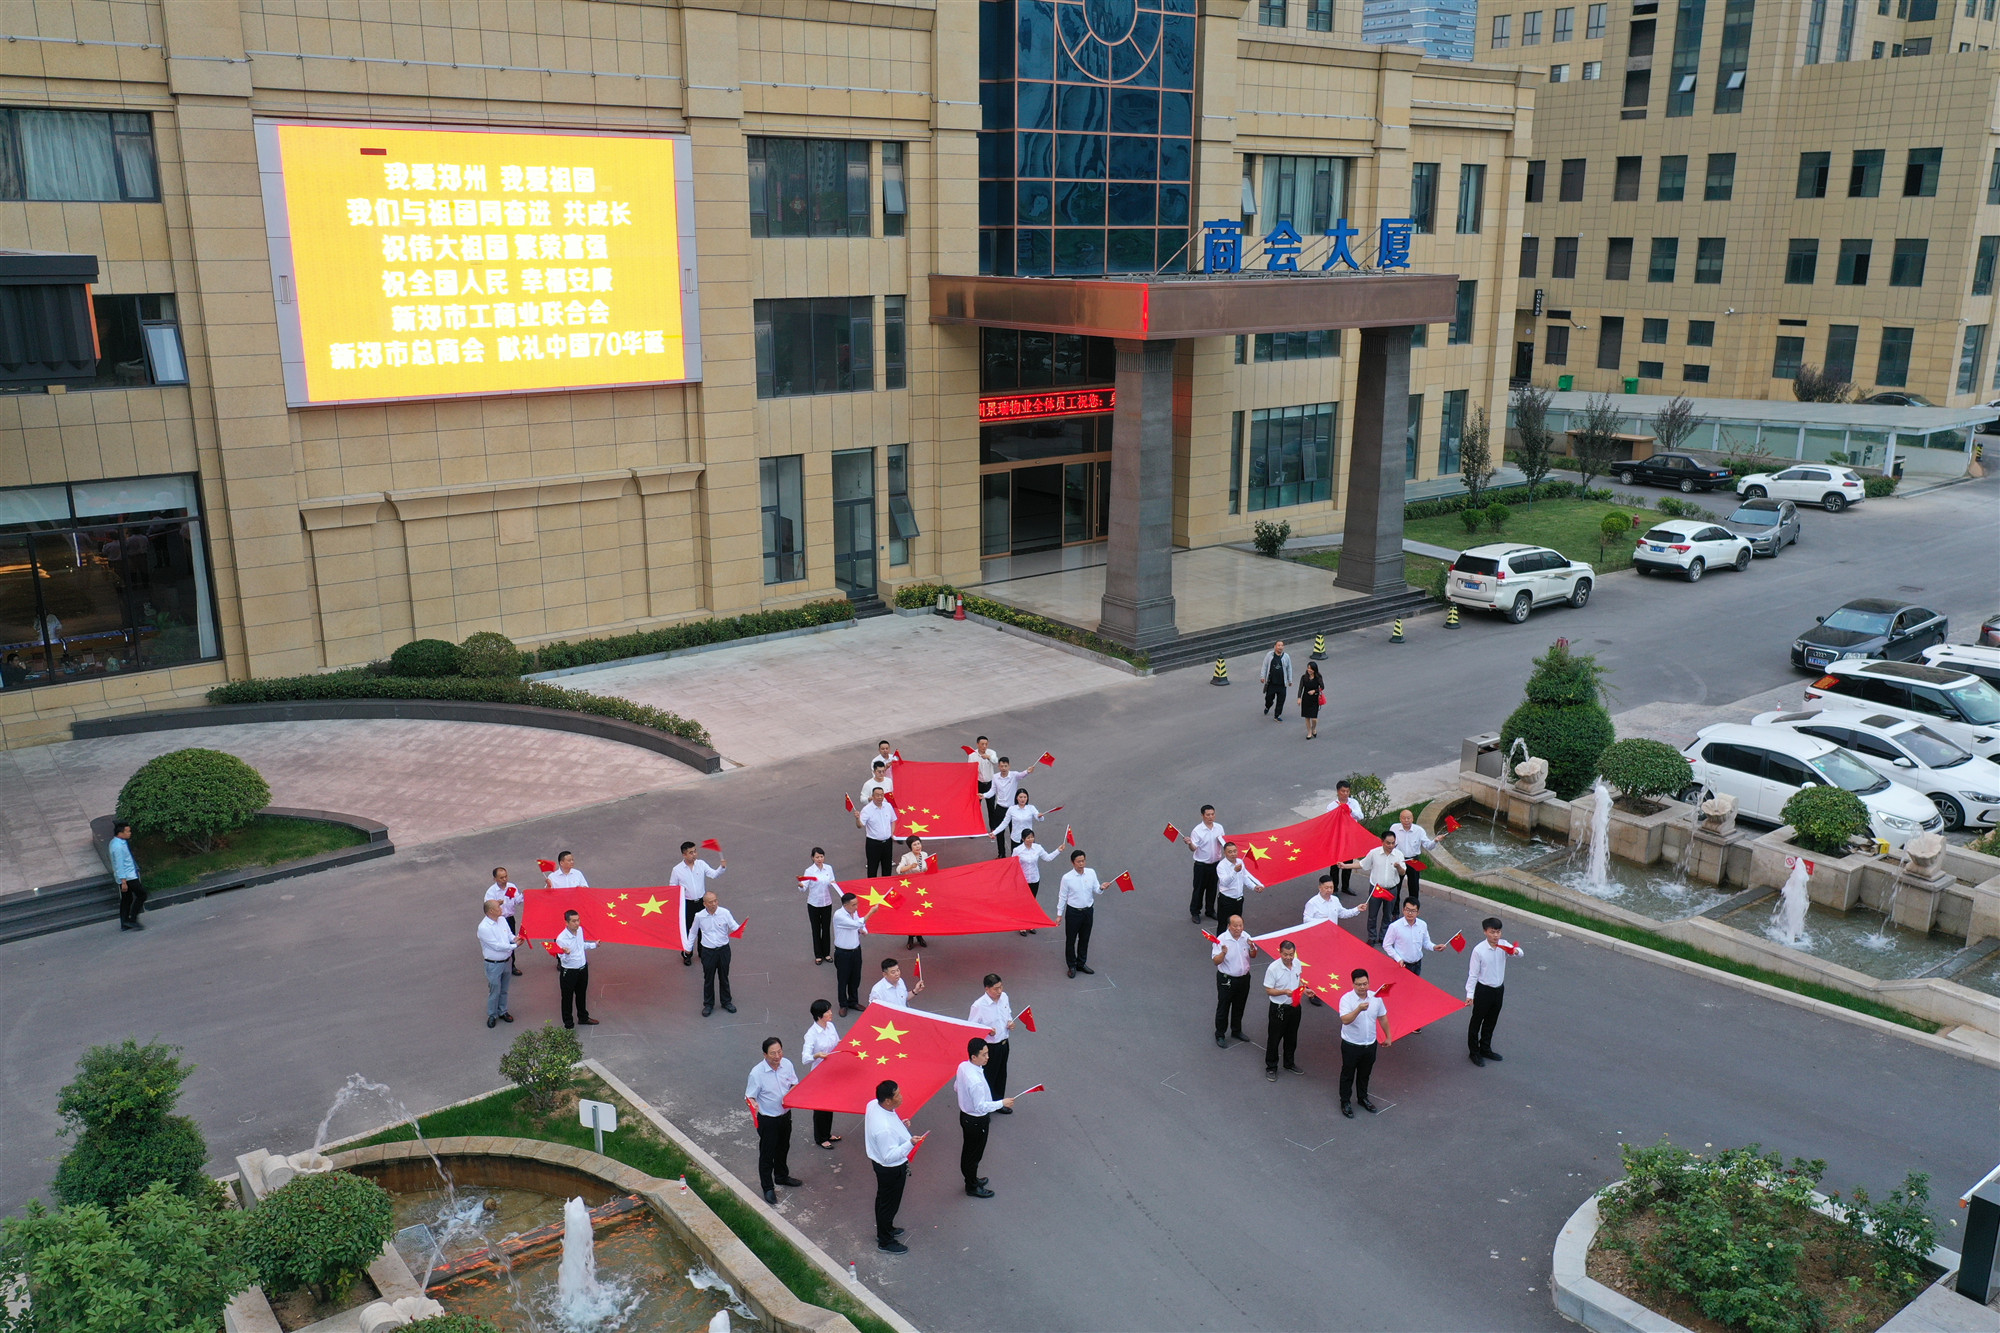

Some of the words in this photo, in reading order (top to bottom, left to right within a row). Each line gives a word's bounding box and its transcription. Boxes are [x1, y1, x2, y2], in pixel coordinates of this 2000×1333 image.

[384, 162, 487, 192] 我爱郑州
[500, 165, 595, 193] 我爱祖国
[347, 198, 552, 227] 我们与祖国同奋进
[563, 200, 632, 227] 共成长
[382, 234, 509, 262] 祝伟大祖国
[514, 234, 609, 260] 繁荣富强
[1203, 218, 1413, 274] 商会大厦
[382, 269, 509, 298] 祝全国人民
[521, 267, 614, 294] 幸福安康
[391, 300, 610, 332] 新郑市工商业联合会
[329, 336, 485, 370] 新郑市总商会
[497, 330, 665, 362] 献礼中国70华诞
